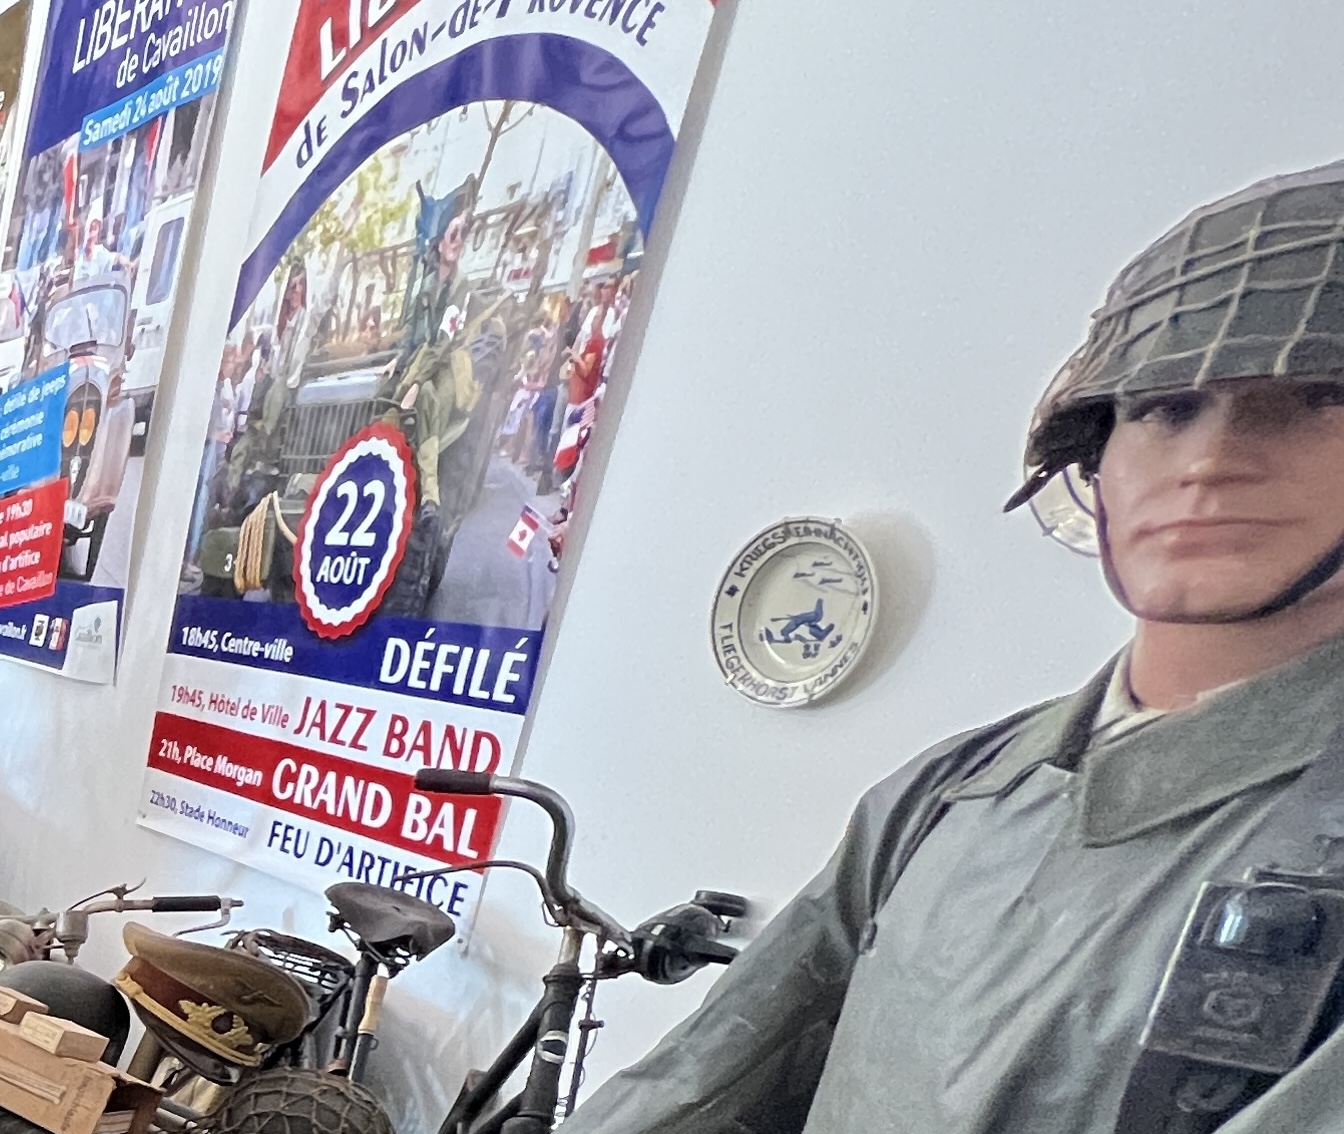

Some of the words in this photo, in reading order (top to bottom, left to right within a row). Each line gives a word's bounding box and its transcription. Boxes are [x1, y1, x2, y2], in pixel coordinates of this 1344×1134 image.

[116, 48, 138, 88] de
[142, 2, 232, 74] Cavaillon
[83, 100, 133, 146] Samedi
[132, 92, 148, 123] 24
[148, 75, 180, 115] août
[180, 54, 223, 98] 2019
[9, 521, 53, 550] populaire
[324, 479, 387, 546] 22
[2, 550, 41, 574] d'artifice
[316, 551, 370, 586] AOÛT
[4, 581, 16, 595] de
[182, 626, 218, 653] 18h45,
[221, 632, 293, 662] Centre-ville
[379, 627, 528, 704] DÉFILÉ
[172, 685, 205, 712] 19h45,
[208, 692, 241, 717] Hôtel
[241, 699, 258, 721] de
[261, 703, 290, 729] Ville
[293, 696, 379, 752] JAZZ
[382, 714, 501, 773] BAND
[159, 739, 181, 764] 21h,
[183, 745, 214, 771] Place
[213, 755, 263, 787] Morgan
[179, 800, 205, 822] Stade
[206, 809, 250, 838] Honneur
[271, 757, 393, 829] GRAND
[400, 793, 480, 859] BAL
[267, 820, 310, 859] FEU
[314, 836, 468, 917] D'ARTIFICE
